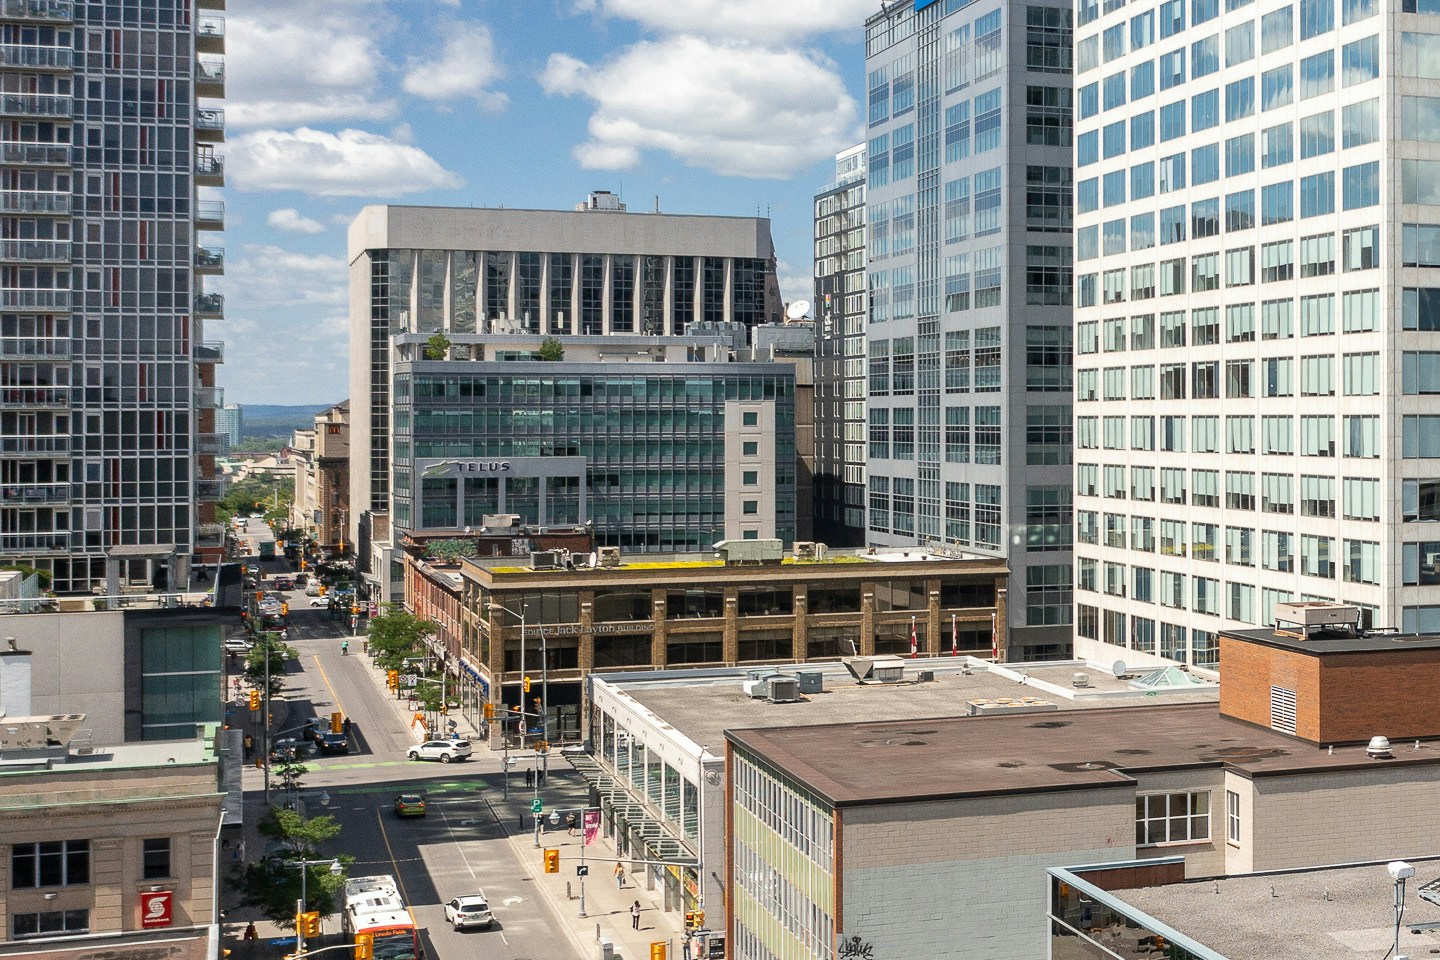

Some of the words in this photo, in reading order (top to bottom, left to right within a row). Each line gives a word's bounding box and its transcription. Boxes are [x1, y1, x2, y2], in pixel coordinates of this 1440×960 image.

[458, 461, 510, 472] TELUS
[555, 626, 577, 635] Jack
[580, 625, 615, 634] Layton
